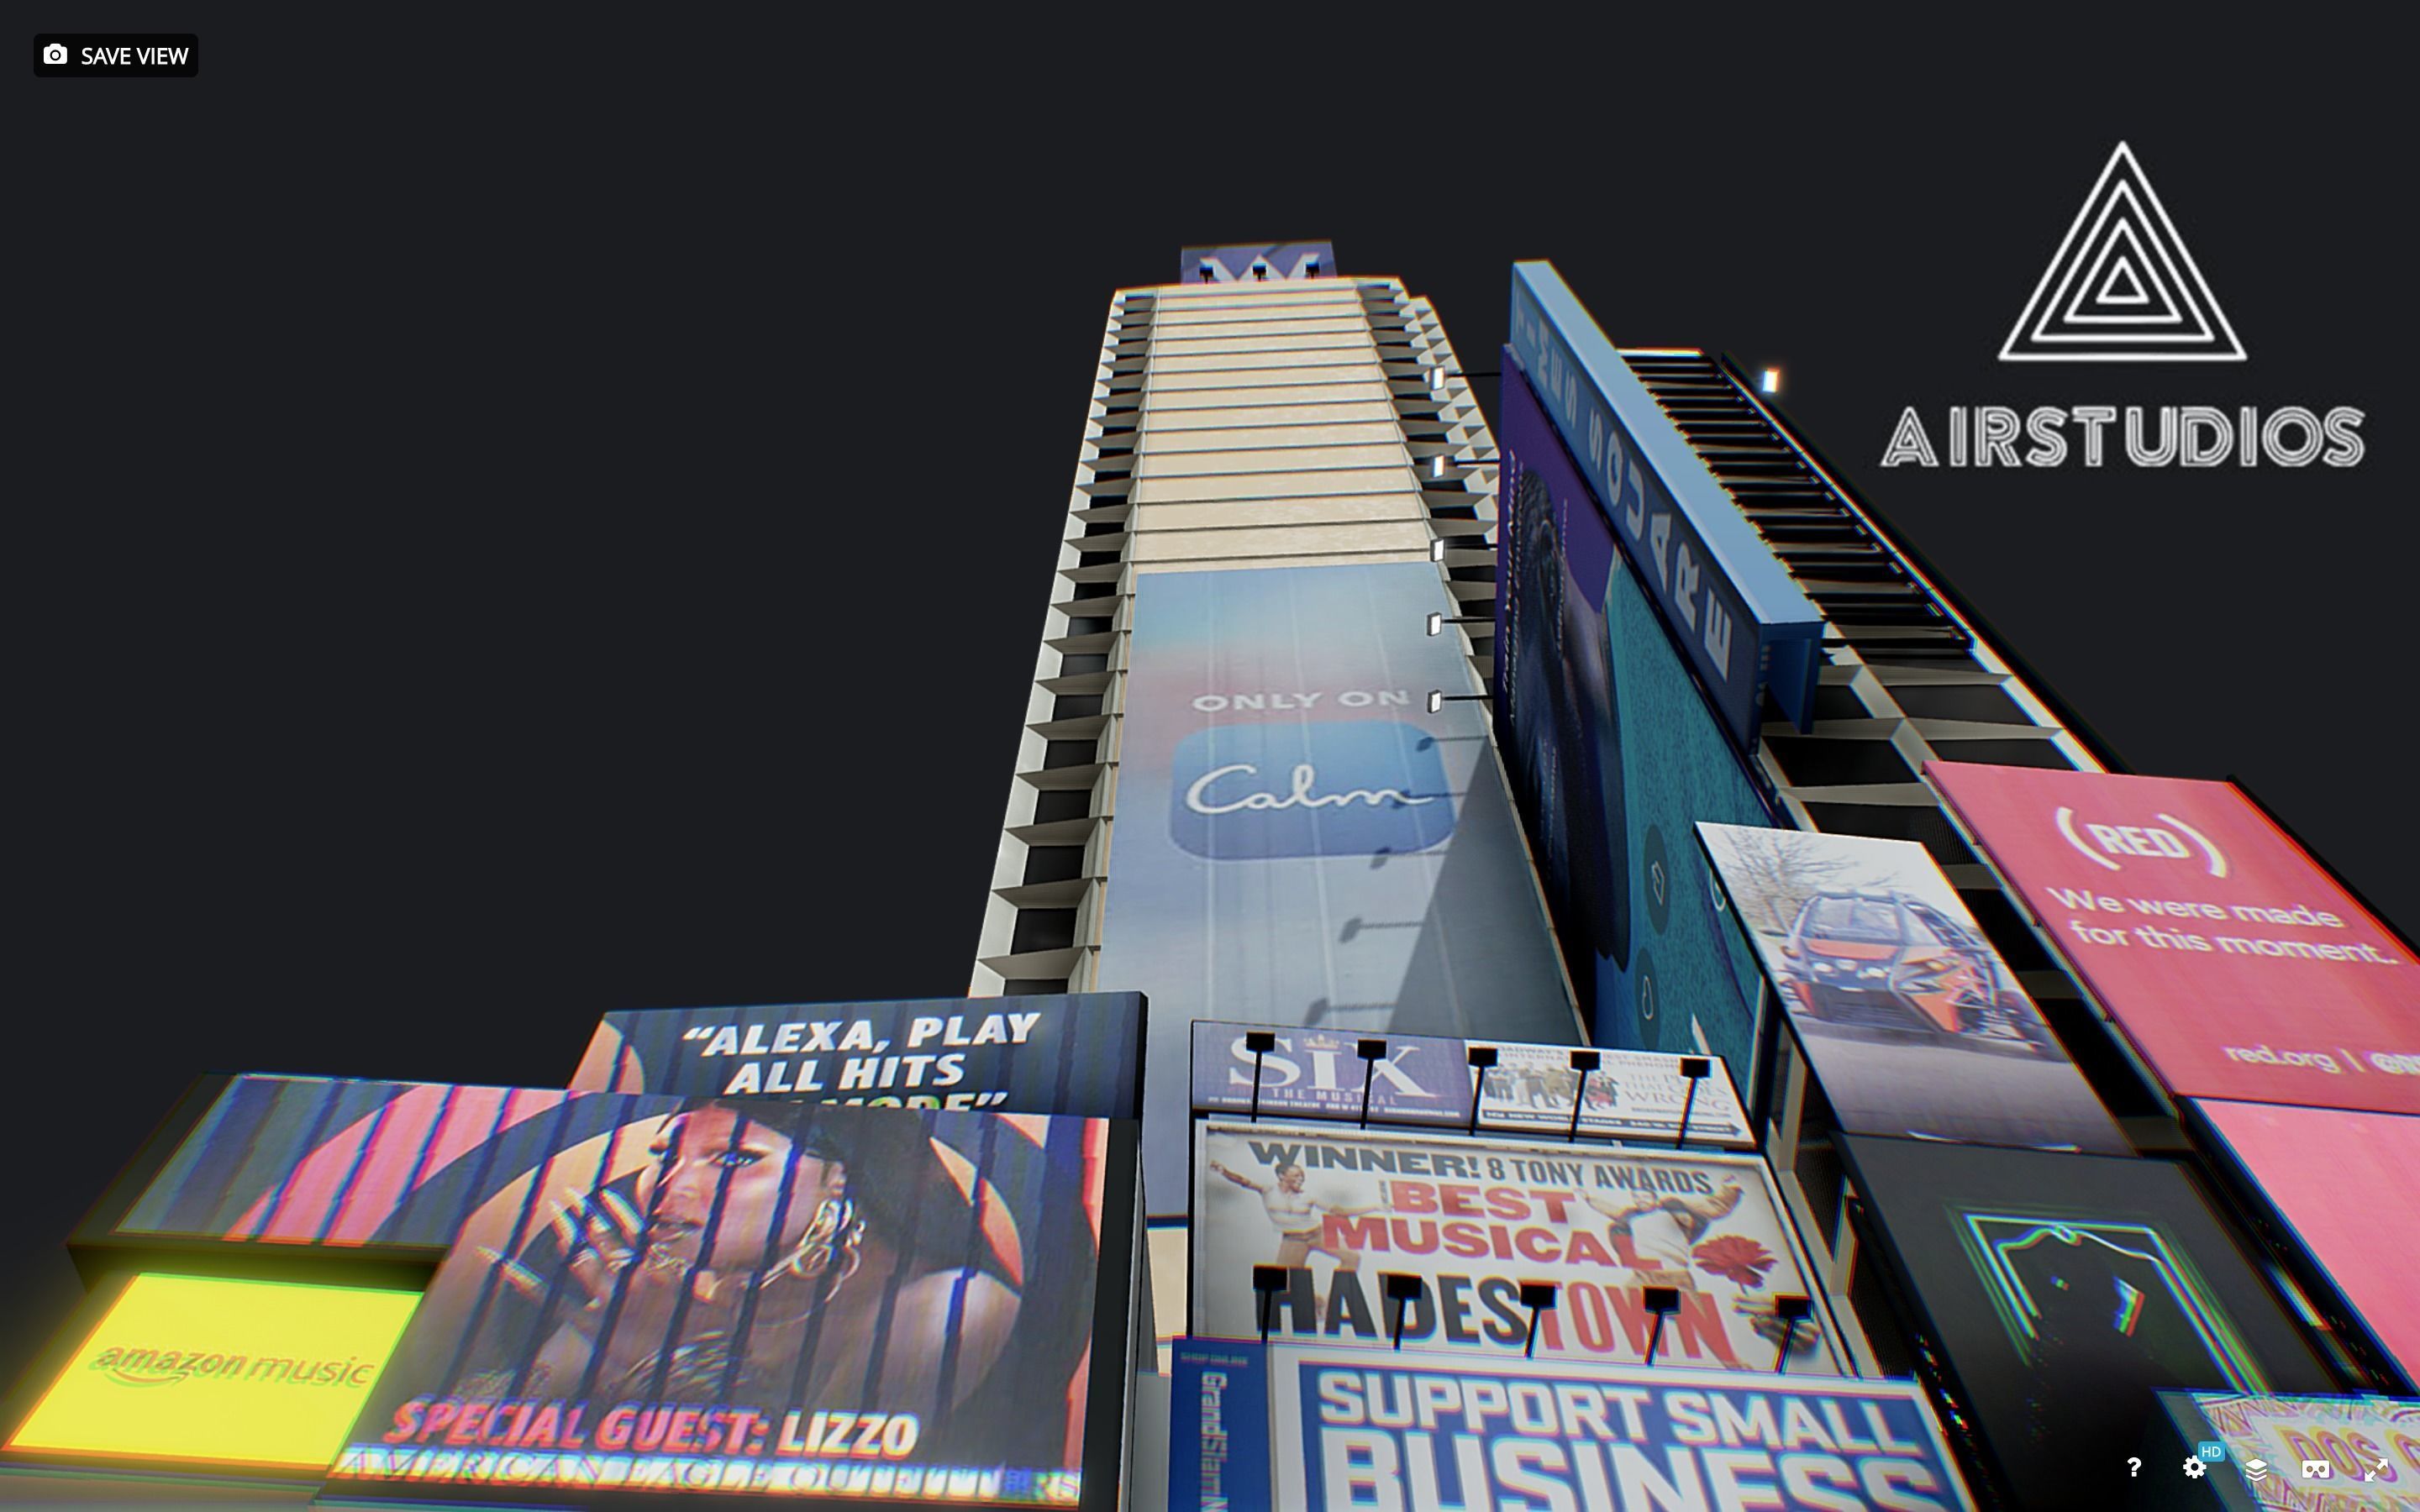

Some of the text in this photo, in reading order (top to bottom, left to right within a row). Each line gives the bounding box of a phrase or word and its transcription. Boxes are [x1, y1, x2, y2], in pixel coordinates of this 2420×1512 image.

[1516, 290, 1578, 430] TIMES
[1192, 689, 1412, 712] ONLY ON
[1186, 763, 1434, 815] Calm
[2055, 806, 2228, 879] (RED)
[2045, 887, 2349, 928] We were made
[2070, 921, 2400, 965] for this moment.
[908, 1011, 1041, 1047] PLAY
[723, 1053, 965, 1095] ALL HITS
[1228, 1034, 1439, 1098] SIX
[2221, 1044, 2342, 1074] red.org
[1271, 1087, 1307, 1100] THE
[1249, 1141, 1712, 1196] WINNER! 8 TONY AWARDS
[1389, 1180, 1576, 1224] BEST
[1322, 1214, 1664, 1271] MUSICAL
[1255, 1267, 1744, 1369] HADESTOWN
[91, 1346, 376, 1389] amazon music
[383, 1399, 920, 1461] SPECIAL GUEST: LIZZO
[1317, 1369, 1923, 1458] SUPPORT SMALL
[334, 1445, 612, 1485] AMERICAN
[618, 1454, 778, 1493] EAGLE
[1320, 1425, 1951, 1512] BUSINESS
[2274, 1425, 2399, 1483] DOS
